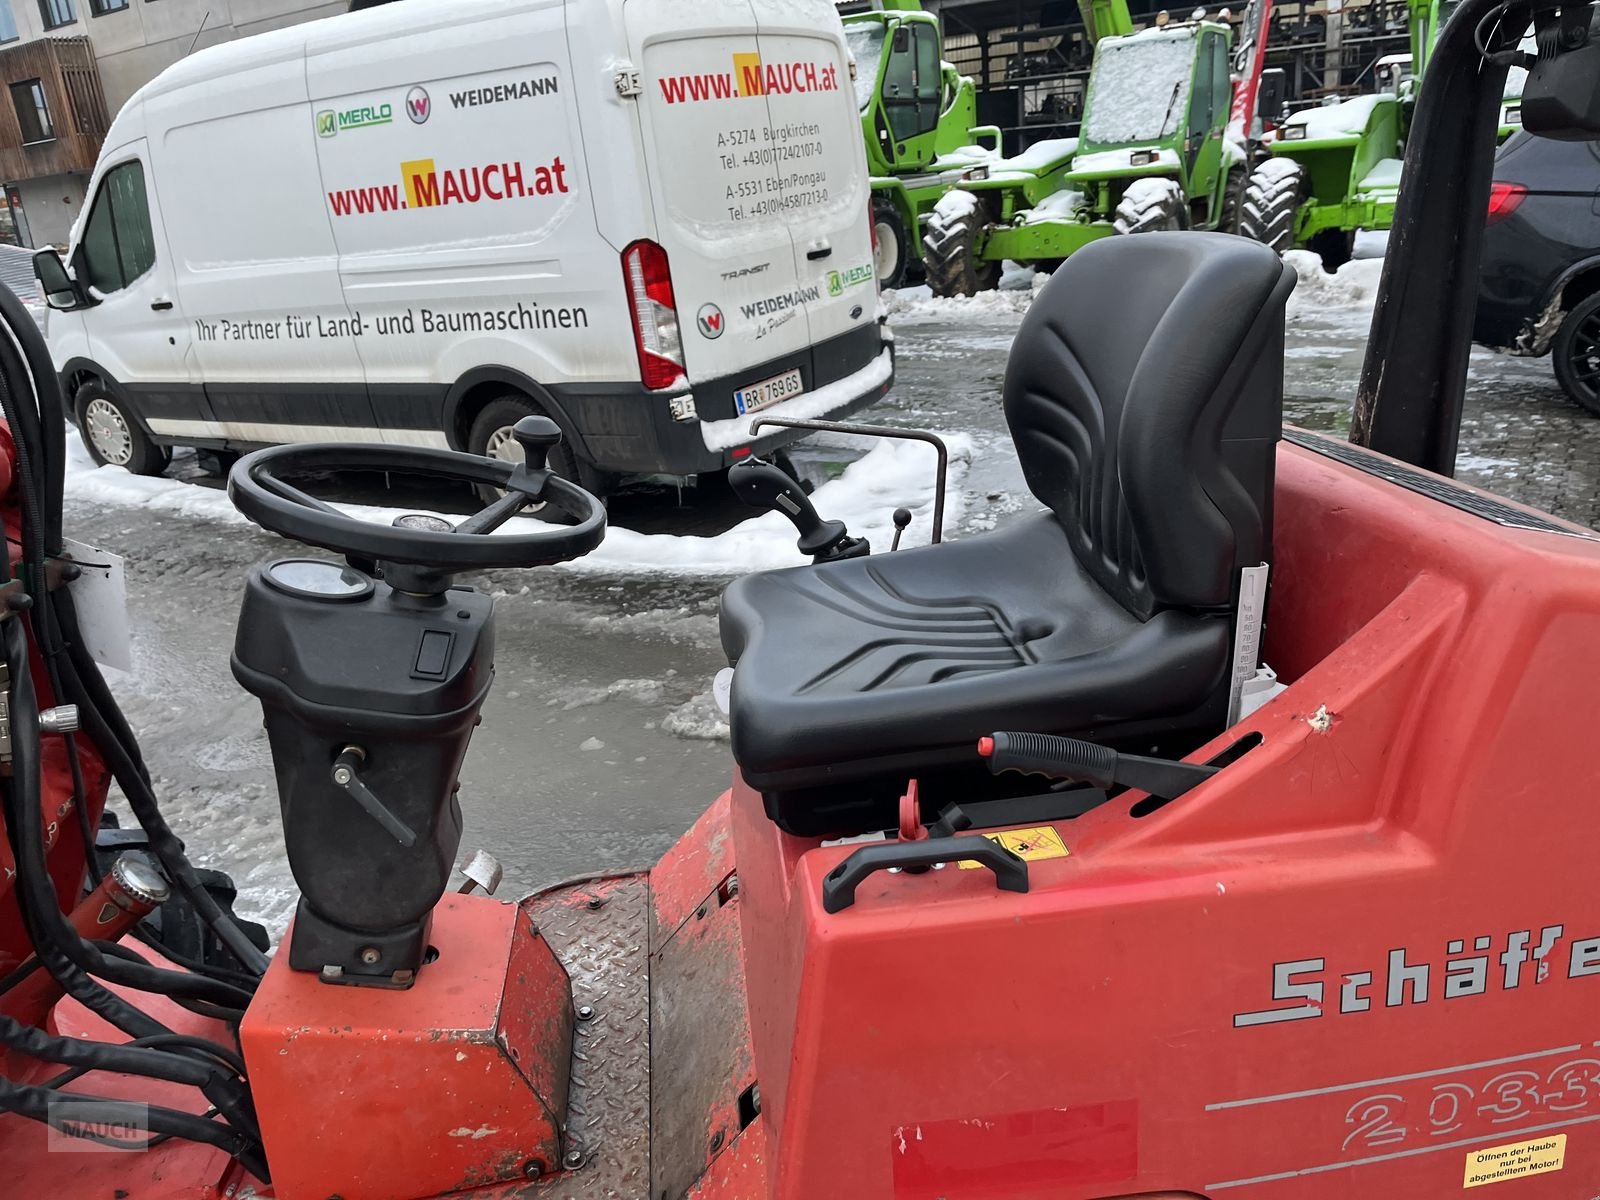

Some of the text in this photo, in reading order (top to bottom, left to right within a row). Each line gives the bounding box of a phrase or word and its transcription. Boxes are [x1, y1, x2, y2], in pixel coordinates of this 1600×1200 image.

[449, 76, 558, 109] WEIDEMANN
[659, 62, 838, 104] www.MAUCH.at
[338, 103, 392, 126] MERLO
[717, 122, 820, 147] A-5274 Burgkirchen
[720, 141, 823, 170] Tel. +43(0)7724/2107-0
[328, 156, 568, 216] www.MAUCH.at
[726, 170, 826, 200] A-5531 Eben/Pongau
[728, 205, 747, 221] Tel.
[720, 262, 770, 281] TRANSIT
[842, 263, 872, 284] MERLO
[740, 286, 821, 320] WEIDEMANN
[195, 302, 589, 341] Ihr Partner für Land- und Baumaschinen
[765, 380, 784, 400] 769
[1477, 1142, 1557, 1163] Öffnen der Haube
[1500, 1155, 1532, 1168] nur bei
[1469, 1158, 1560, 1183] abgestelltem Motor!
